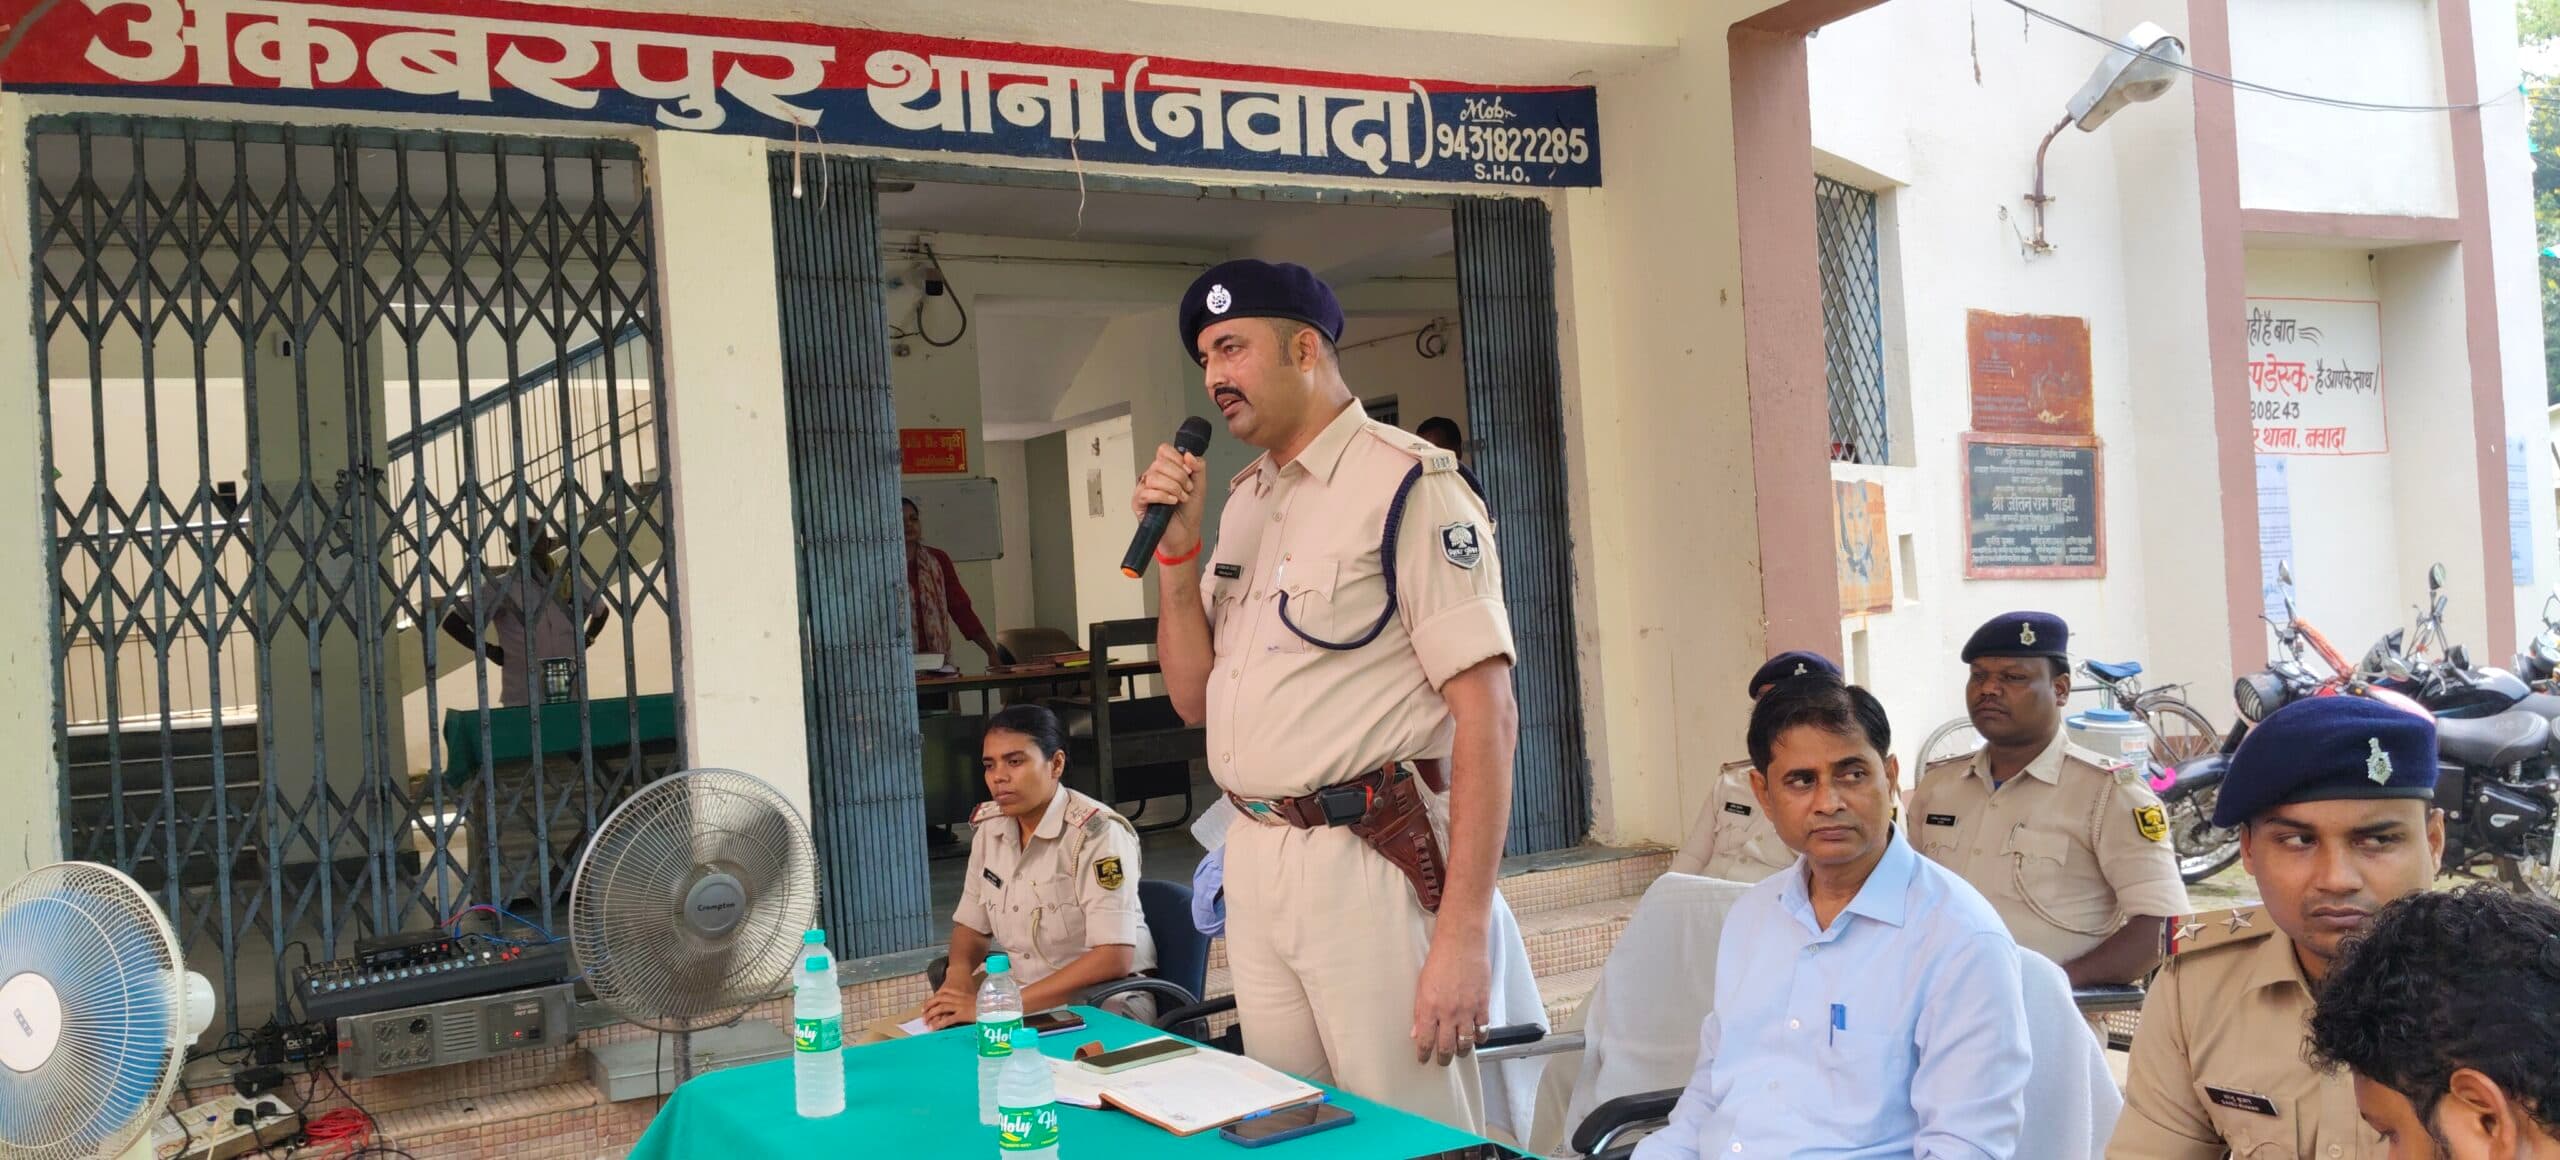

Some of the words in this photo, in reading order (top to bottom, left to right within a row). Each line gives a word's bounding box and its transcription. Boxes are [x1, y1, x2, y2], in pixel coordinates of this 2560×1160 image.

[84, 0, 835, 130] अकबरपुर
[865, 50, 1115, 142] थाना
[1125, 57, 1433, 175] (नवादा)
[1436, 123, 1589, 164] 9431822285
[1474, 163, 1531, 183] S.H.O.
[2274, 319, 2296, 344] बात
[2305, 427, 2347, 456] नवादा
